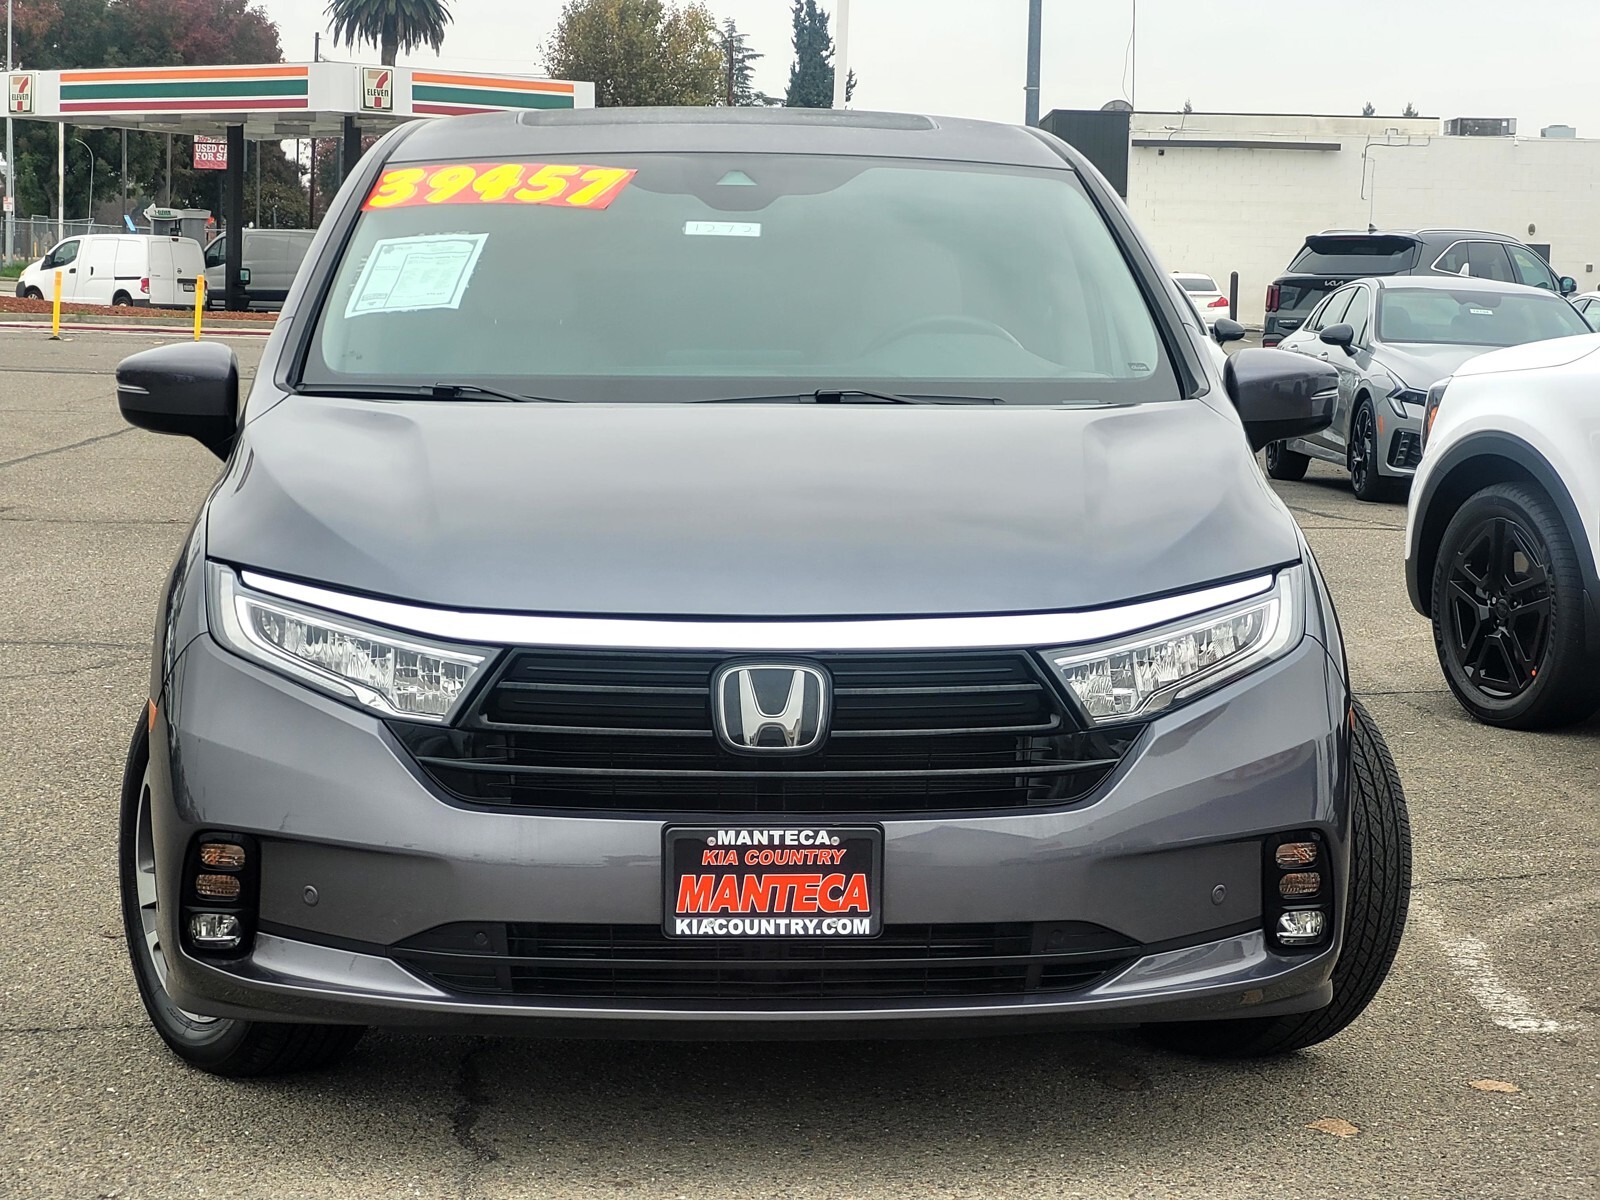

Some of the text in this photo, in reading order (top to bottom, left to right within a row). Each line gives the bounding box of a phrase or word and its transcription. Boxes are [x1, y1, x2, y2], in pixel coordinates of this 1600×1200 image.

[195, 144, 217, 152] USED
[369, 163, 630, 208] 39457
[717, 830, 831, 846] MANTECA
[702, 849, 847, 866] KIA COUNTRY
[676, 873, 870, 913] MANTECA
[675, 918, 870, 935] KIACOUNTRY.COM
